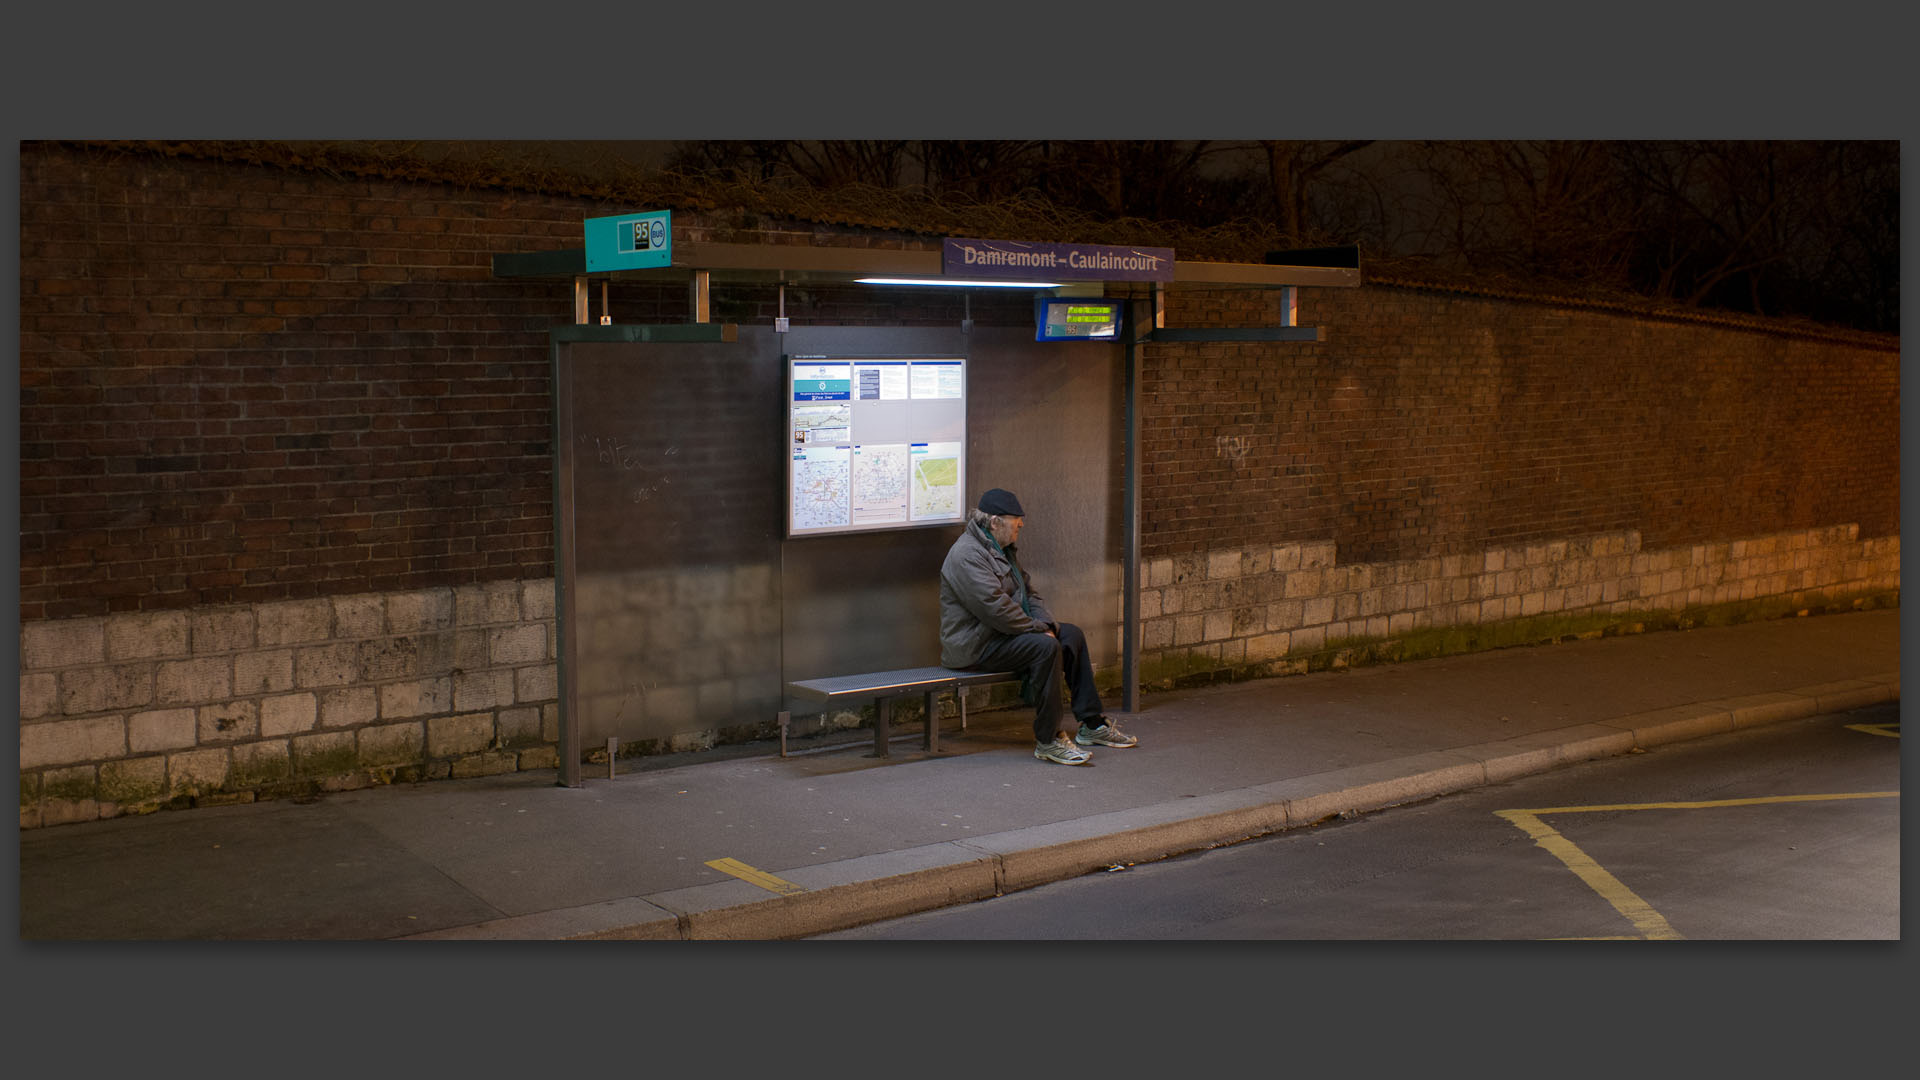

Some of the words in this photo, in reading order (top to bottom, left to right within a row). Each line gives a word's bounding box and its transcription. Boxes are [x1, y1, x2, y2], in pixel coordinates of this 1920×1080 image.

[635, 223, 649, 239] 95
[652, 230, 664, 239] BUS
[795, 431, 804, 439] 95
